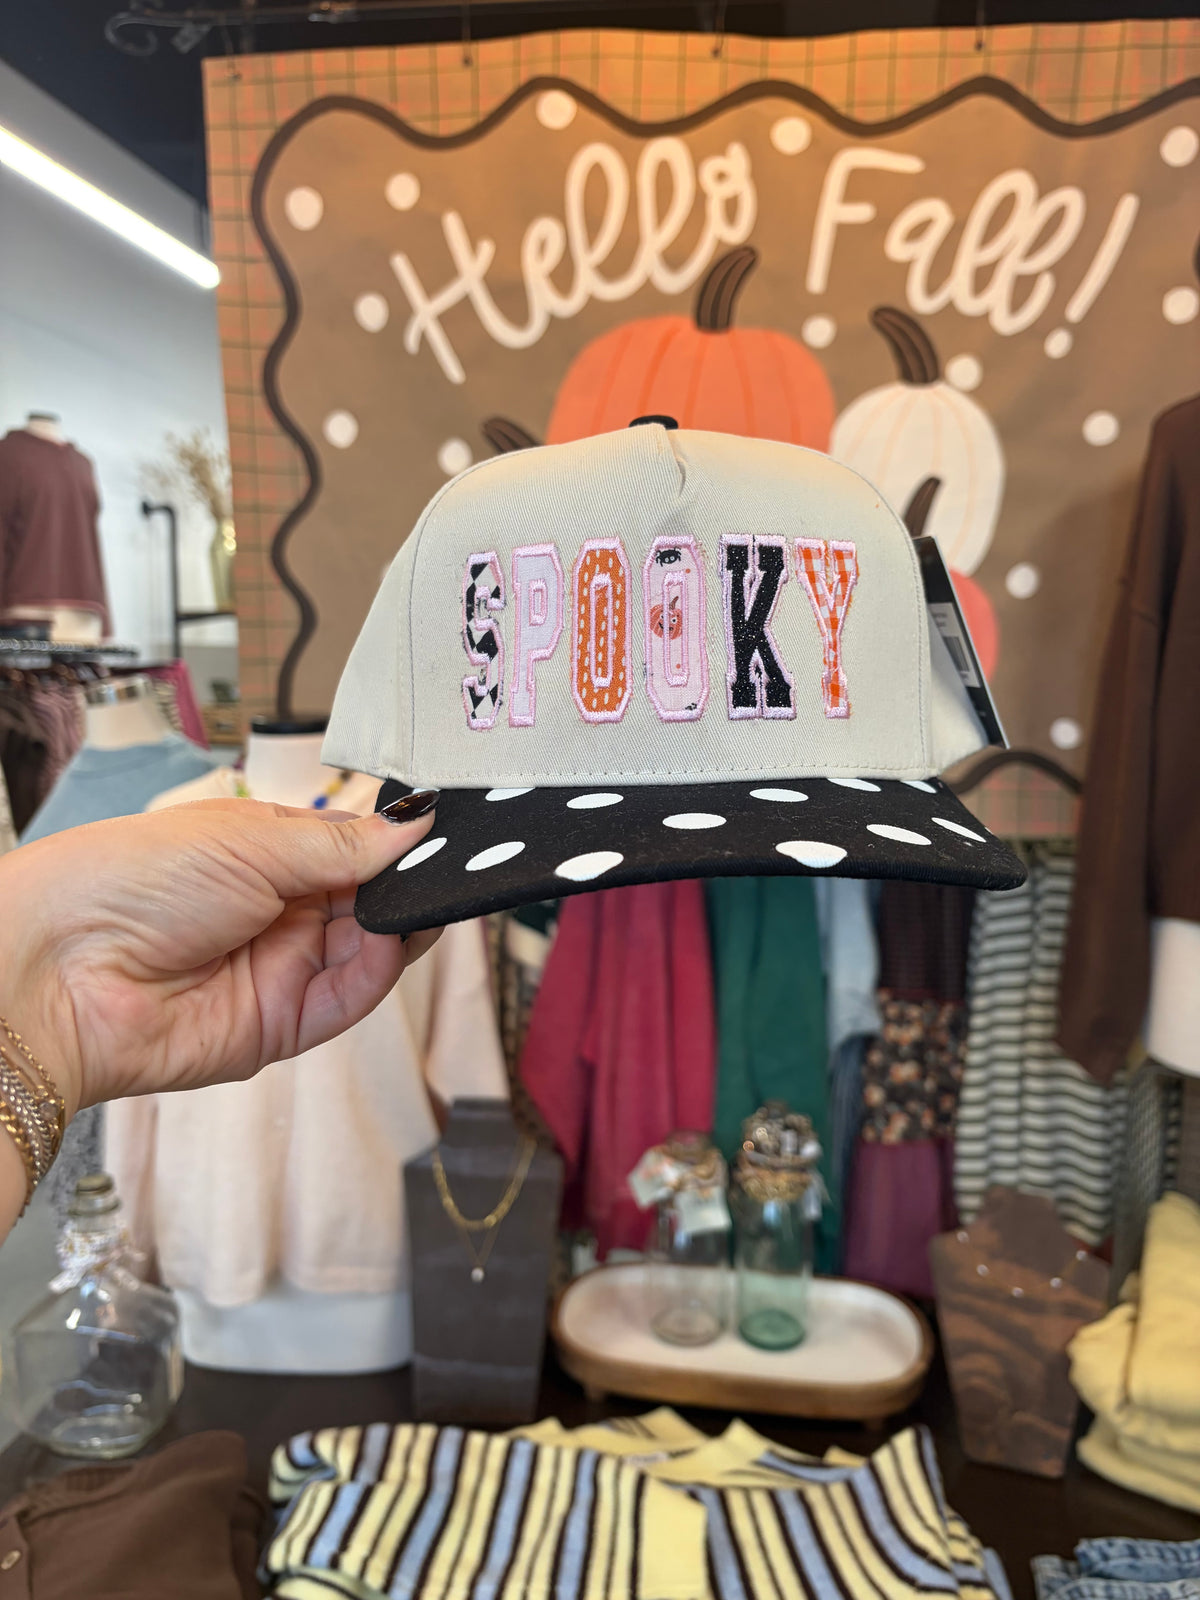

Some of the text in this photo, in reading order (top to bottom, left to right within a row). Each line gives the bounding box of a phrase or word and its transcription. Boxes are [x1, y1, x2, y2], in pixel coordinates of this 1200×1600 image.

[391, 136, 1139, 384] Hello Fall!
[461, 533, 860, 731] SPOOKY
